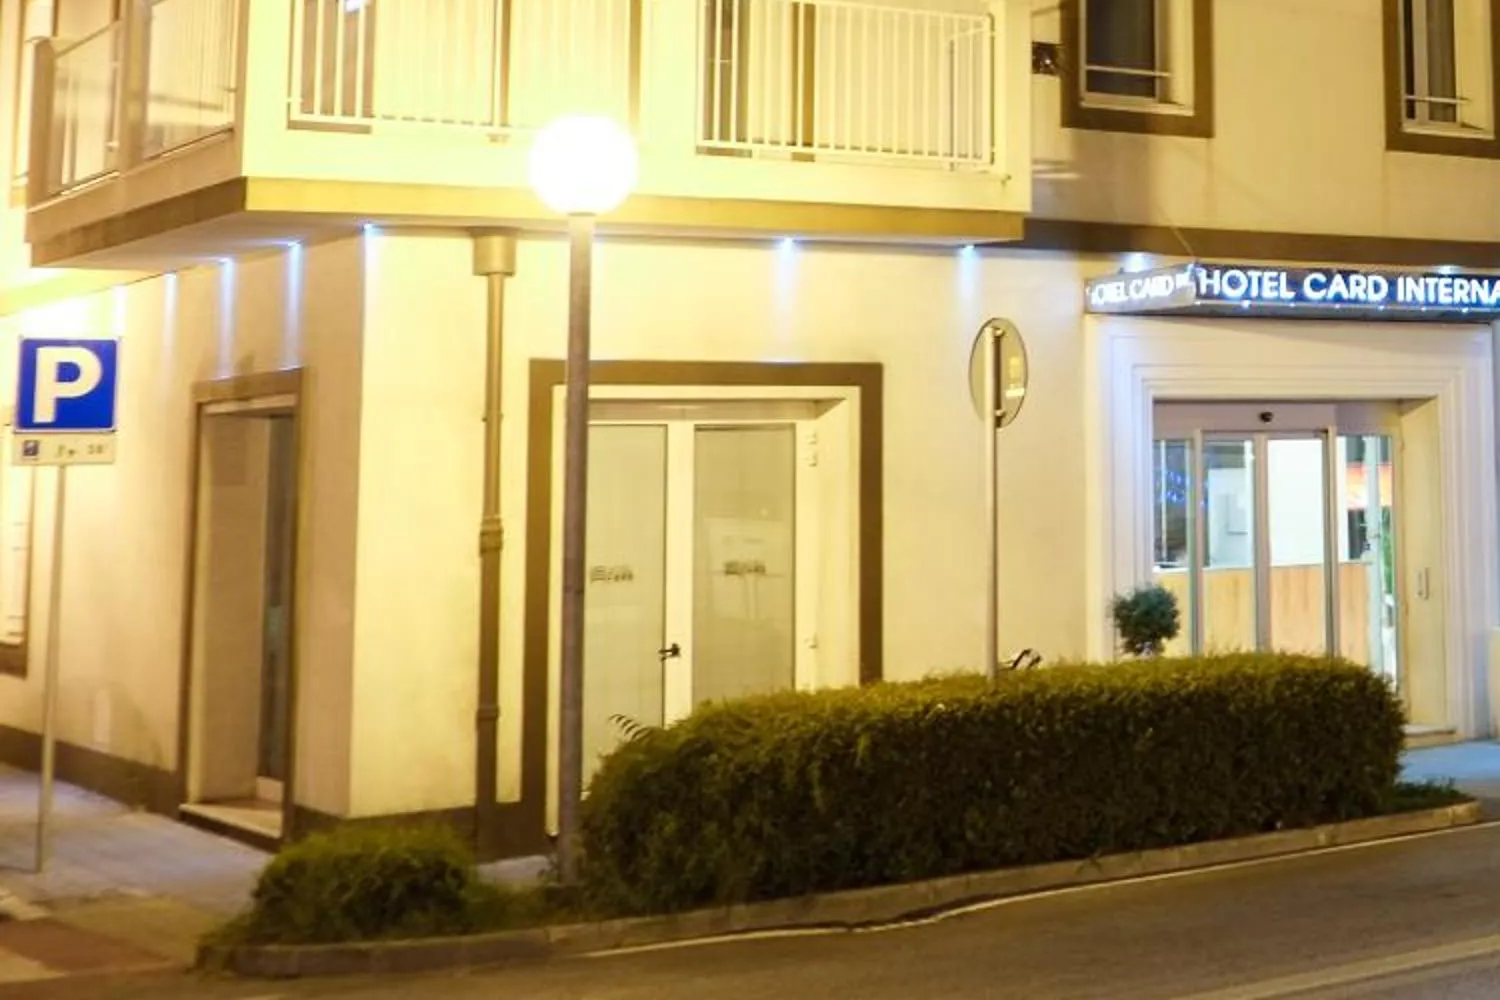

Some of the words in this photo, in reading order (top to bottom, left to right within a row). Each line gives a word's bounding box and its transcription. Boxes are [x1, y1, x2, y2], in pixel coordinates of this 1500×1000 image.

[1200, 268, 1296, 299] HOTEL
[1303, 272, 1388, 302] CARD
[32, 345, 104, 424] P
